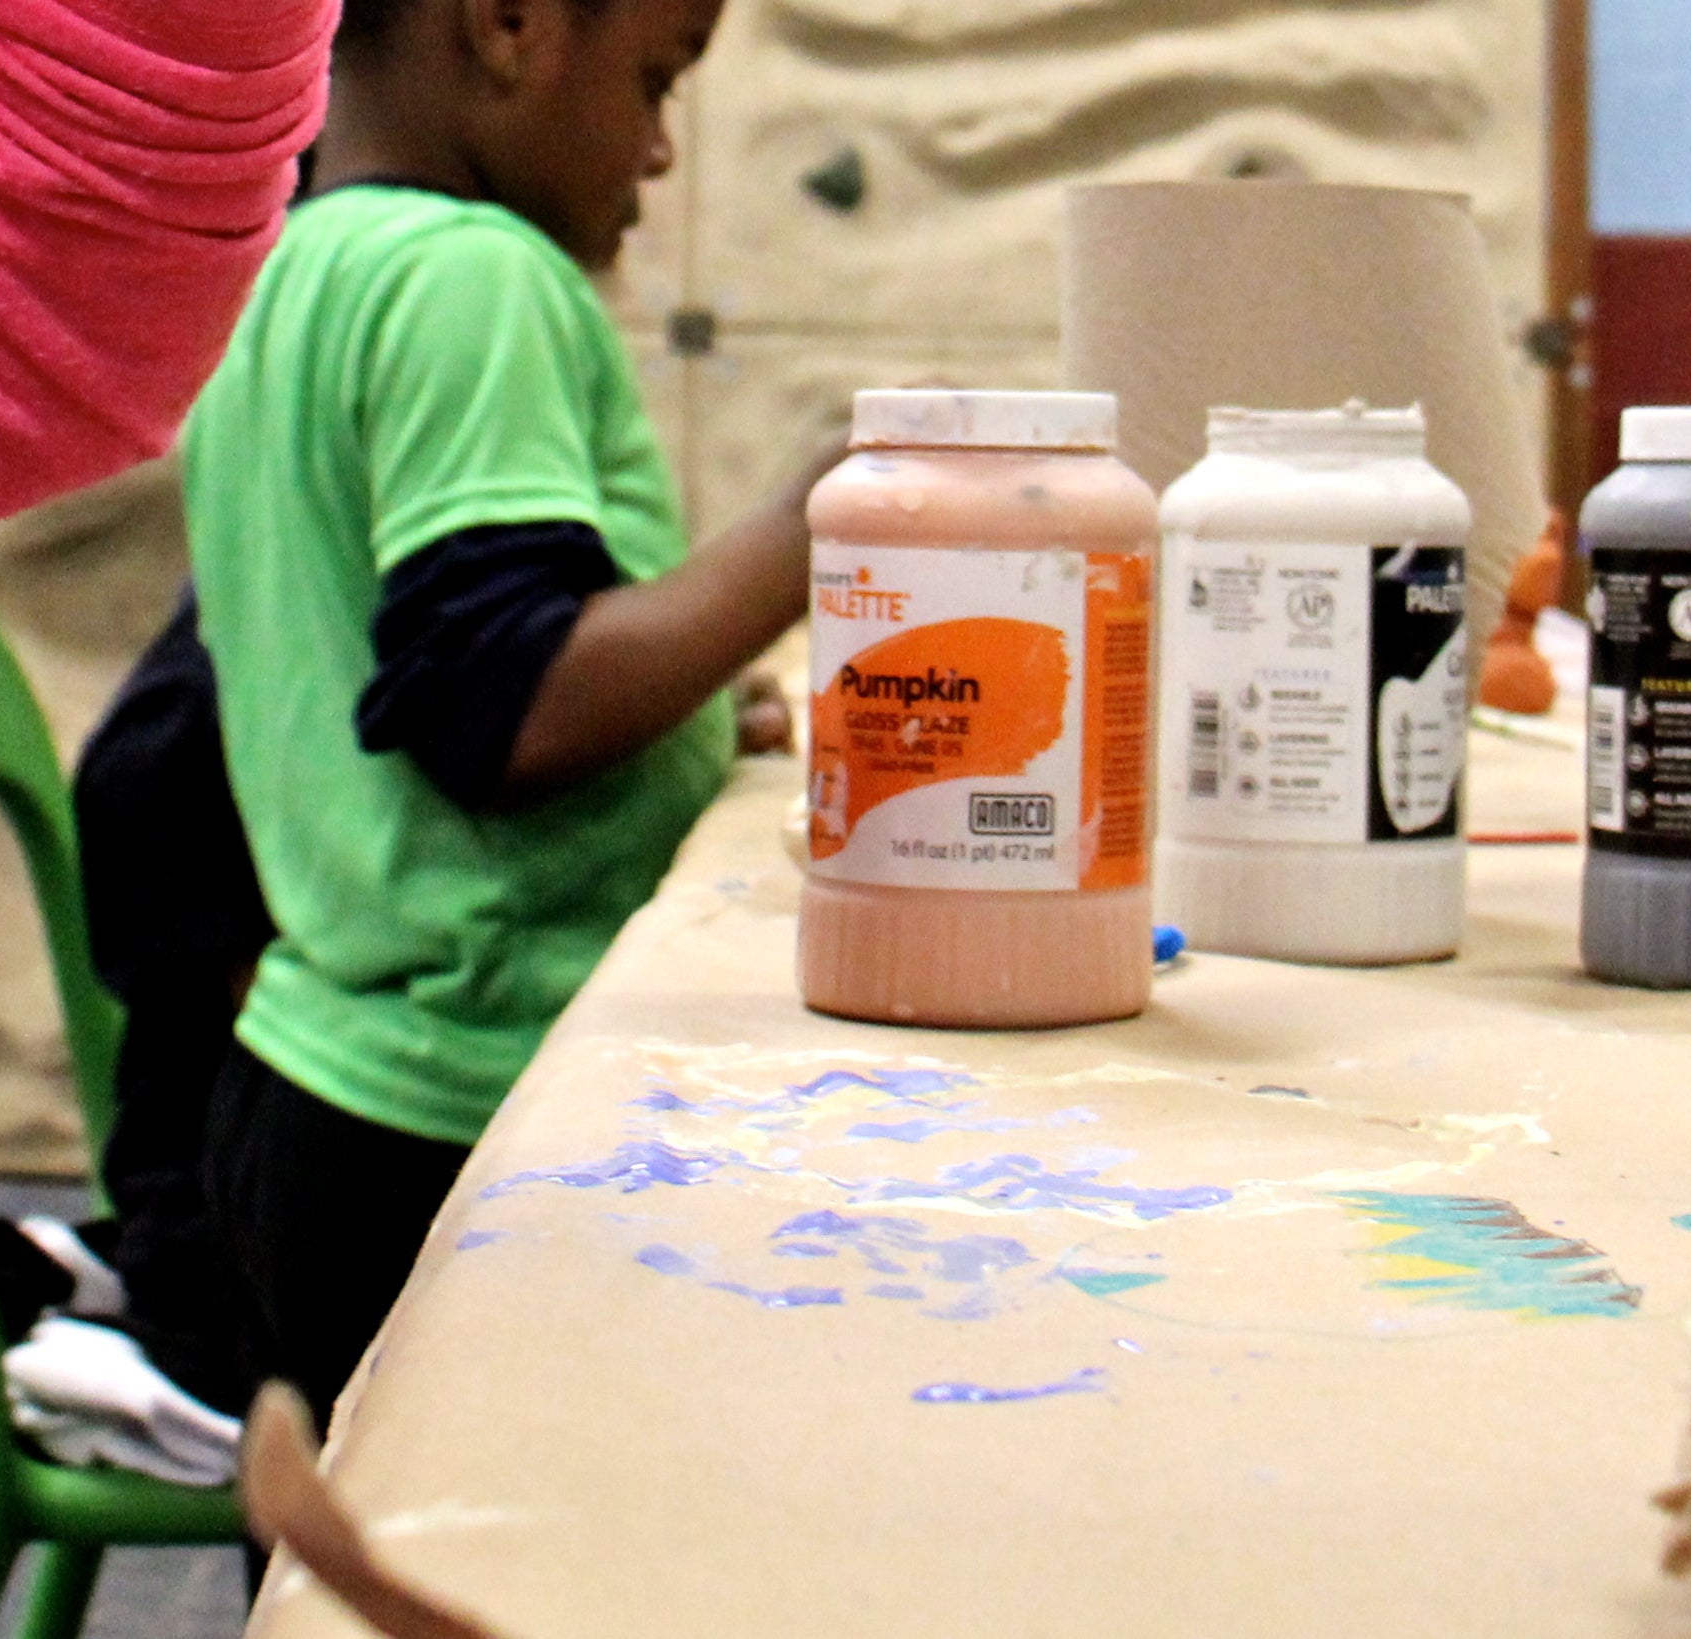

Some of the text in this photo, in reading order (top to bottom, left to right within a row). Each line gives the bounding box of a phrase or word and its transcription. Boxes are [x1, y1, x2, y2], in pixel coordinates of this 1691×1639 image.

[840, 664, 980, 708] Pumpkin
[844, 710, 970, 735] GLOSS LAZE
[976, 799, 1048, 828] AMACO
[928, 845, 949, 859] oz
[1000, 843, 1031, 861] 472
[1034, 843, 1055, 859] ml
